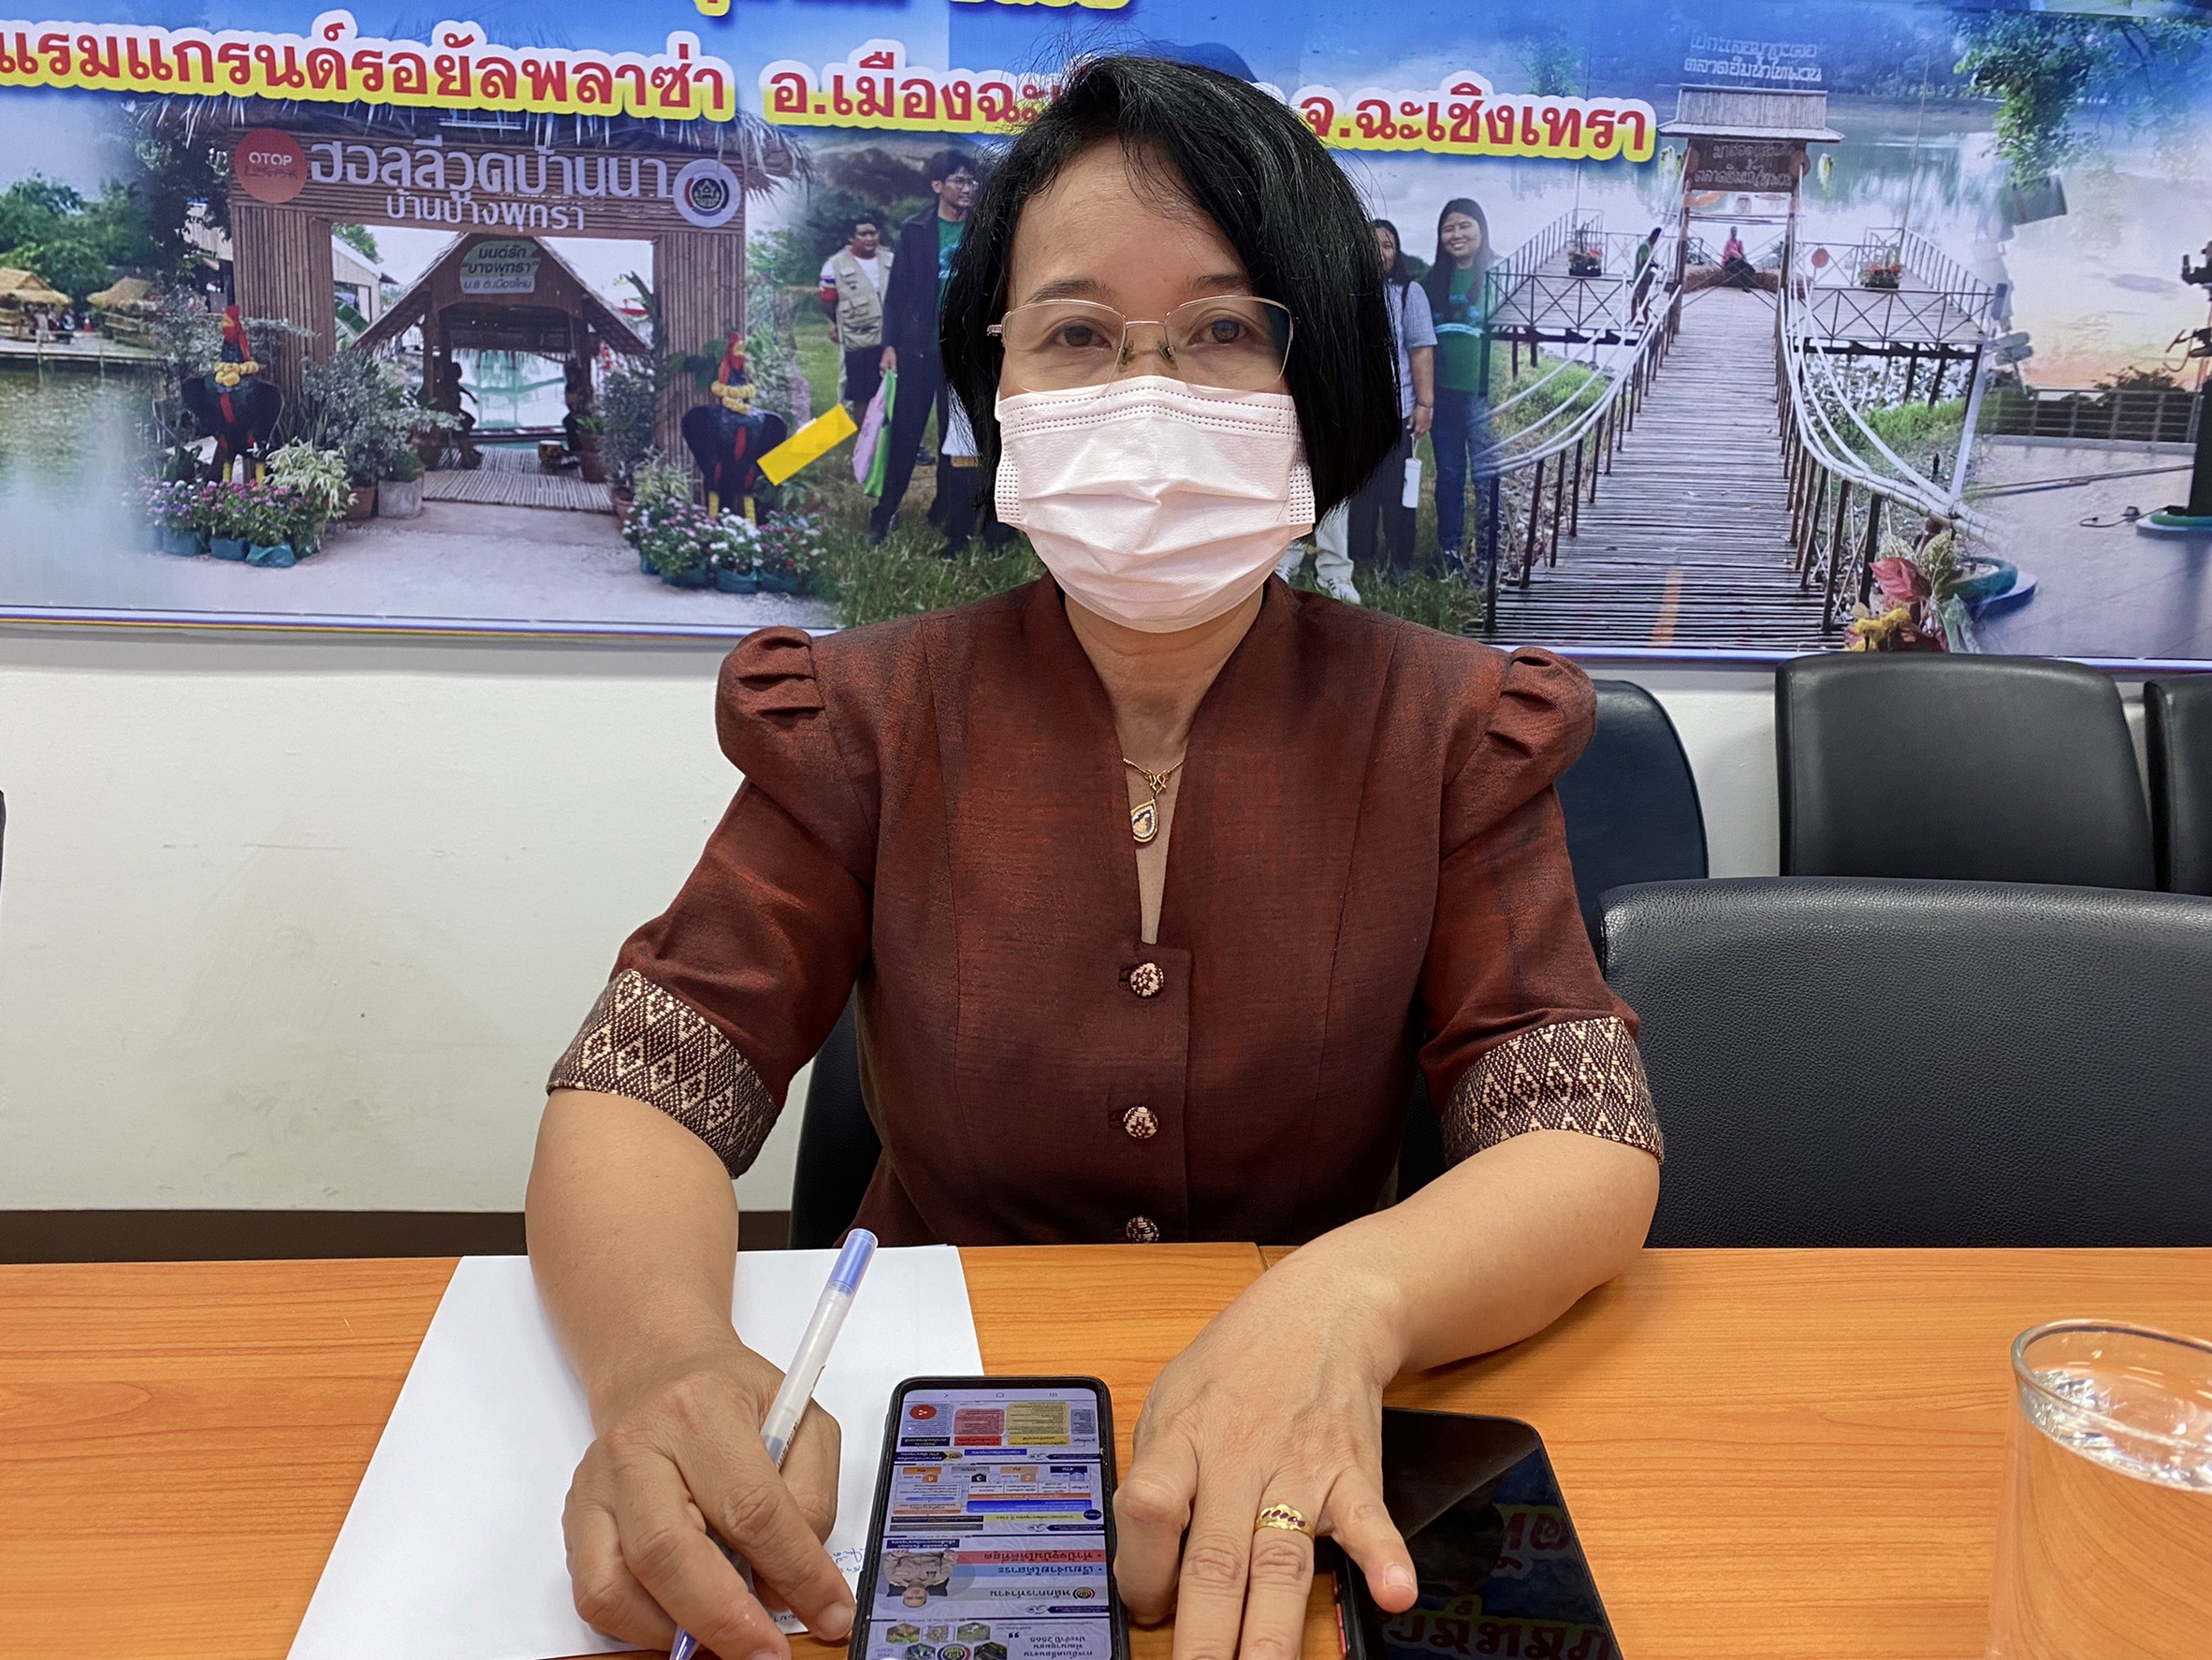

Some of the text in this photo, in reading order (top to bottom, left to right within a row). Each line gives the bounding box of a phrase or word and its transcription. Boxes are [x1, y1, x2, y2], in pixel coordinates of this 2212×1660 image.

[1300, 82, 1647, 152] จ.ฉะเชิงเทรา
[248, 151, 293, 167] OTOP
[311, 135, 668, 203] ฮอลลีวูดบ้านนา
[386, 190, 586, 232] บ้านบางพุทรา
